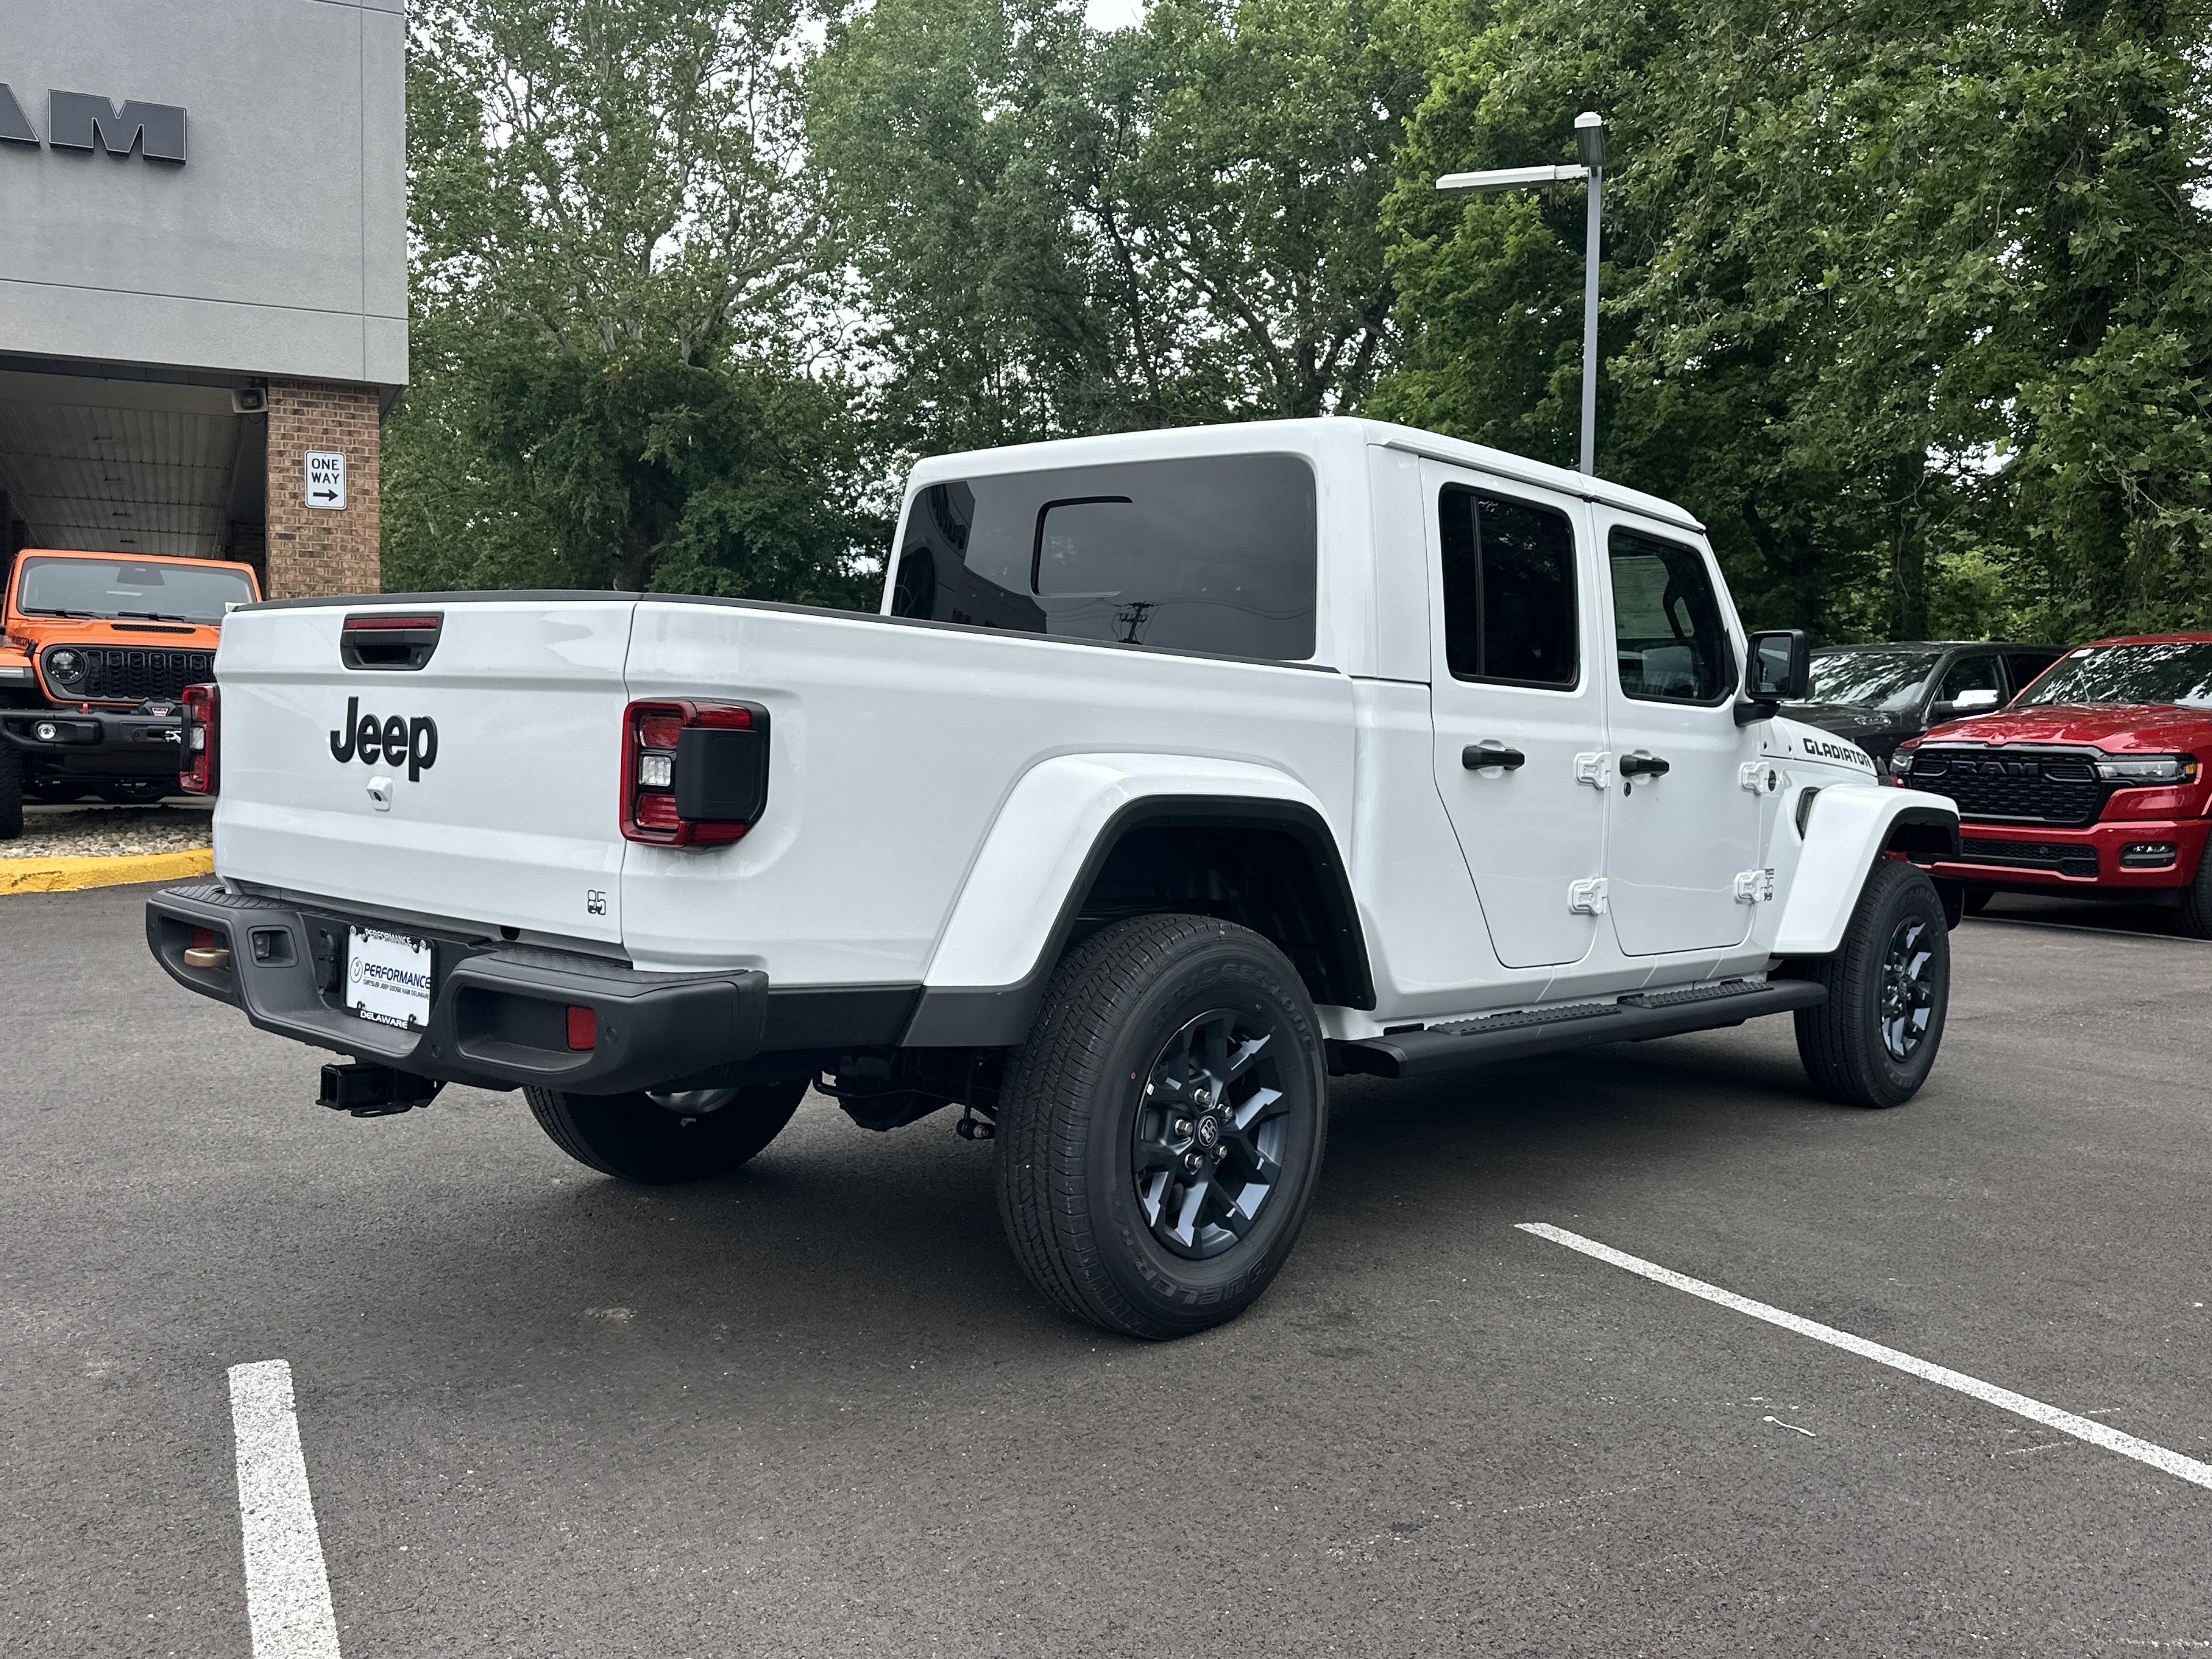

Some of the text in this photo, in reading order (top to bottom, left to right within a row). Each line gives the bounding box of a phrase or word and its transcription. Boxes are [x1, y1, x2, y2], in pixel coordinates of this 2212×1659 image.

[312, 458, 340, 470] ONE
[311, 472, 340, 484] WAY
[330, 696, 438, 782] Jeep
[1803, 738, 1872, 768] GLADIATOR
[1951, 760, 2039, 775] RAM
[364, 928, 413, 947] PERFORMANCE
[364, 963, 431, 990] PERFORMANCE
[360, 1010, 408, 1029] DELAWARE
[1134, 1251, 1267, 1305] DUELER
